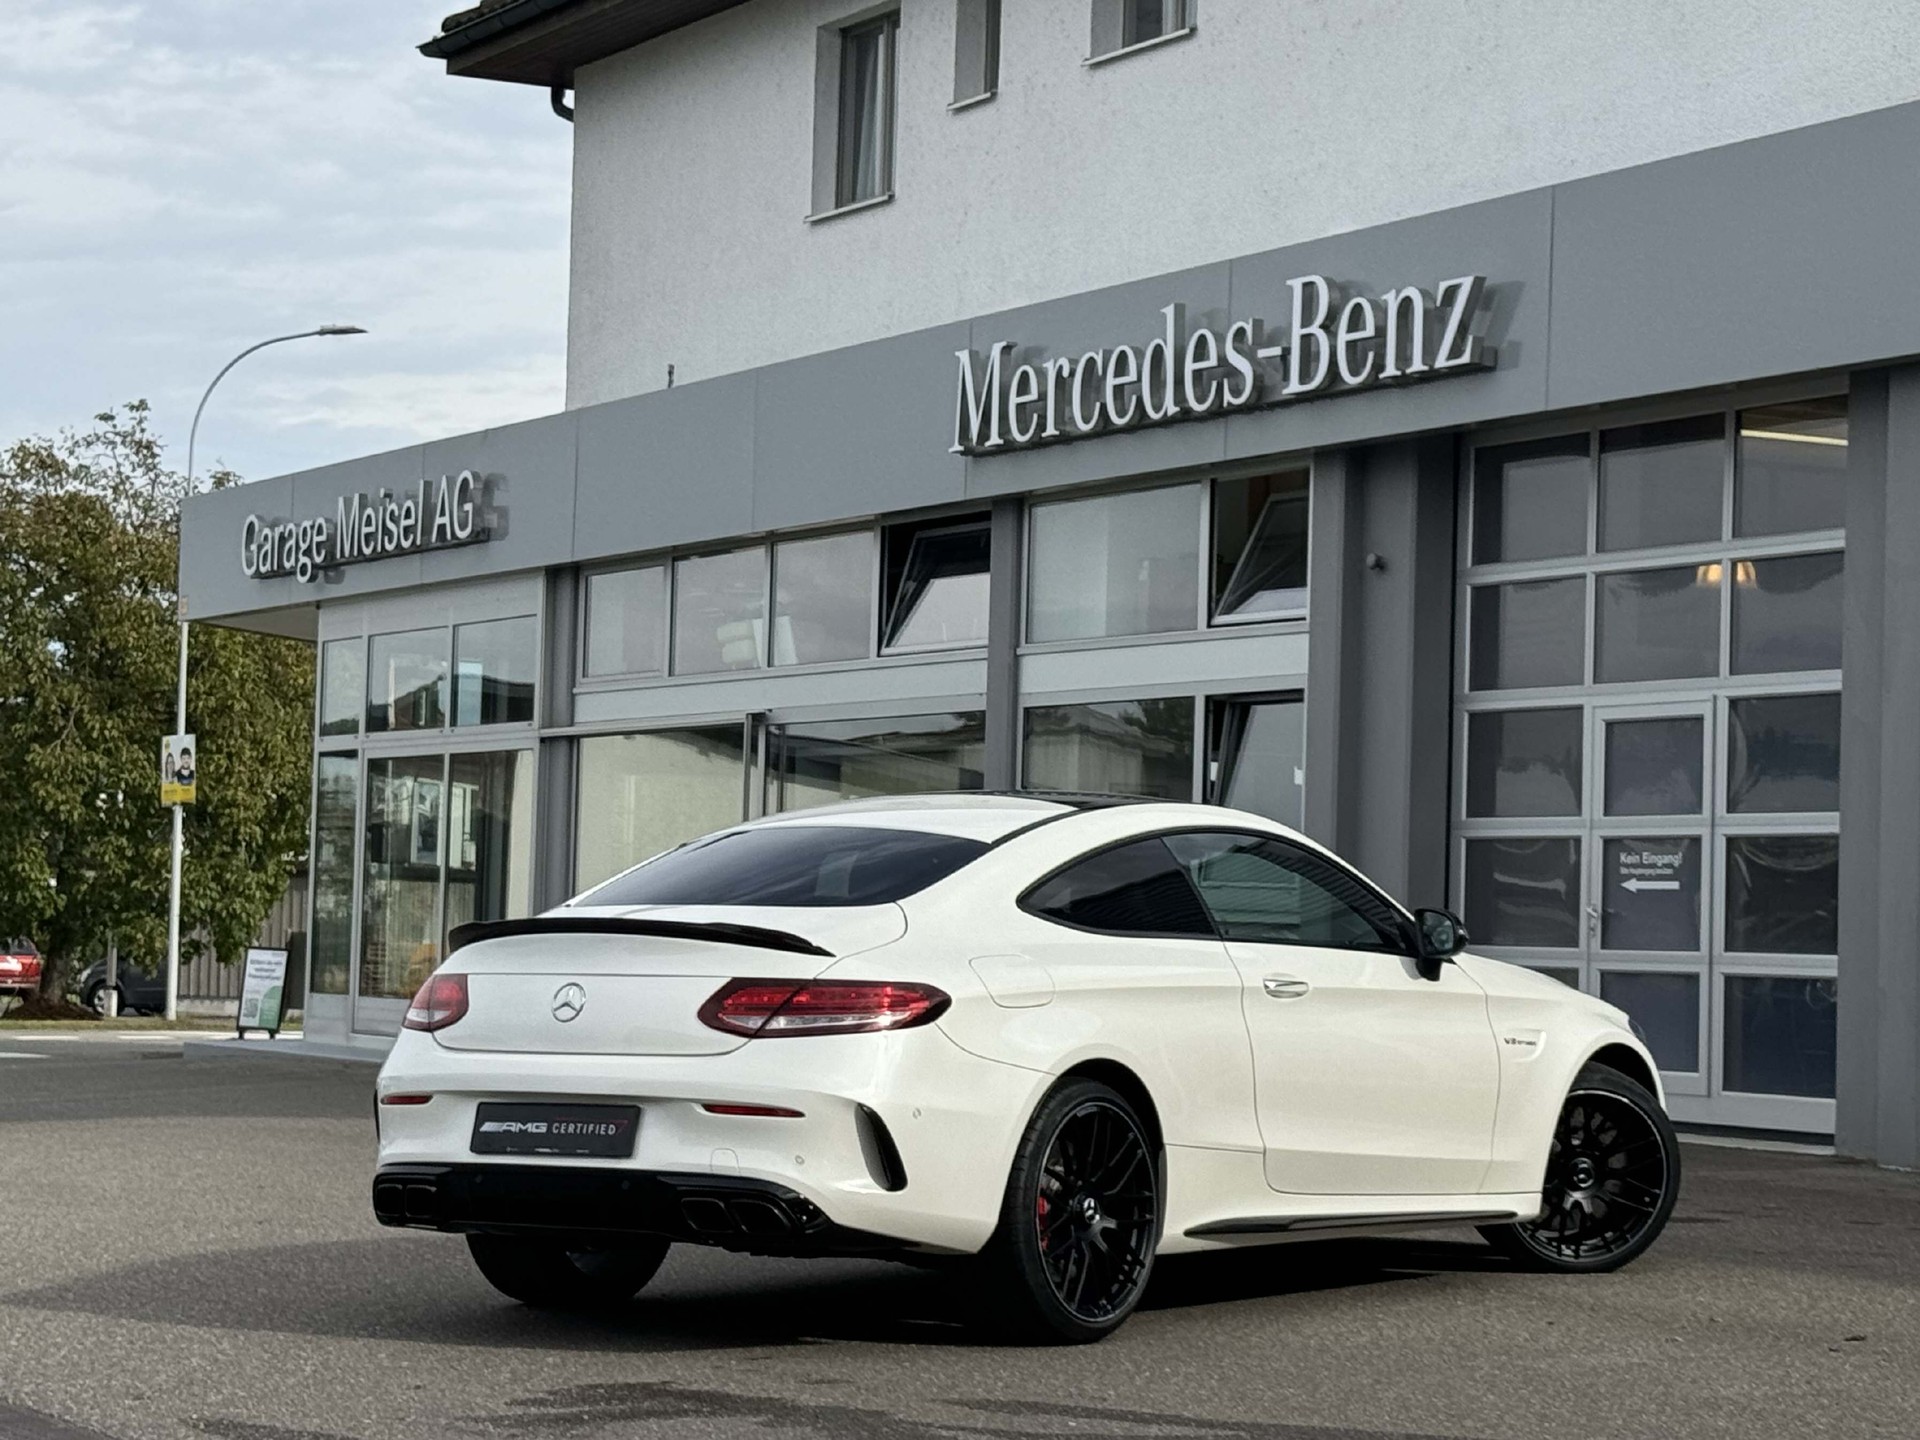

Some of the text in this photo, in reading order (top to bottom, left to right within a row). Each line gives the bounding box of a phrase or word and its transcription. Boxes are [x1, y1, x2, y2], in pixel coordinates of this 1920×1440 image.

[948, 274, 1478, 454] Mercedes-Benz
[241, 469, 474, 583] Garage Meisel AG
[496, 1121, 617, 1135] AMG CERTIFIED
